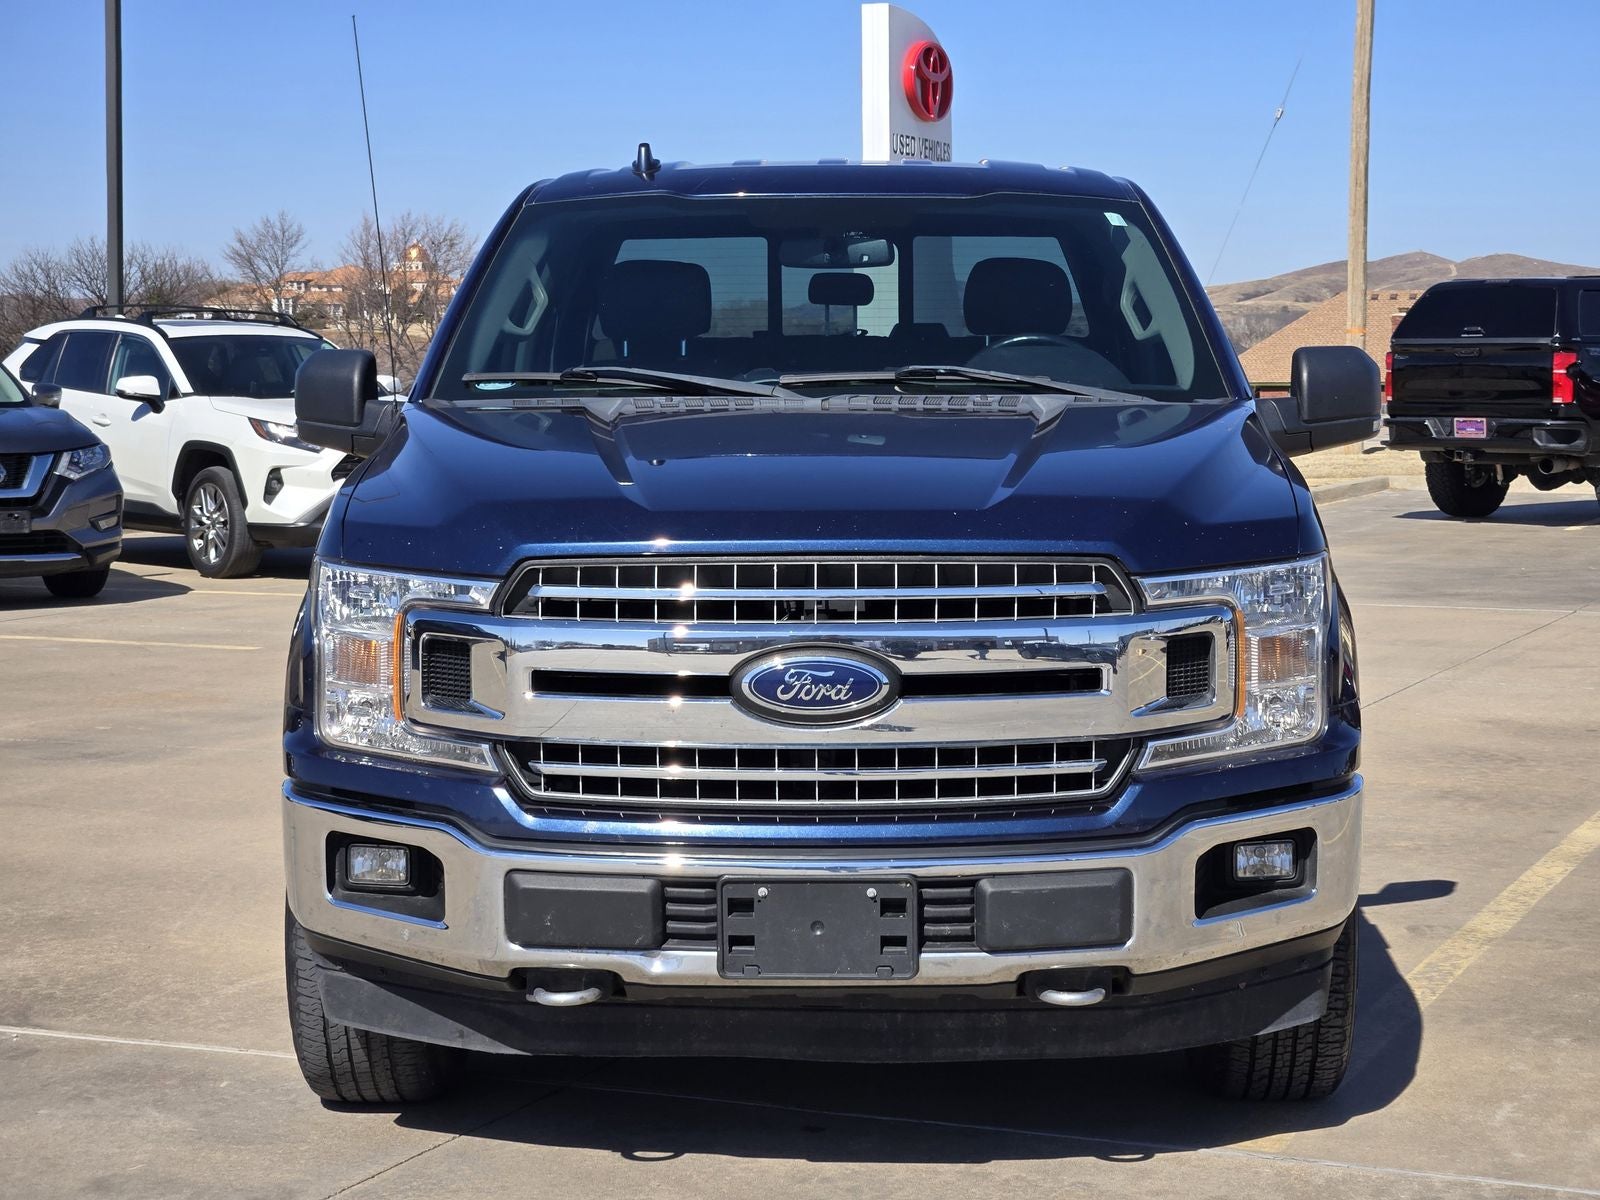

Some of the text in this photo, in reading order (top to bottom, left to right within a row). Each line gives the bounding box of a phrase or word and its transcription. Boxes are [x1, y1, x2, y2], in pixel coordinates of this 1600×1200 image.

[892, 133, 951, 162] USED VEHICLES
[776, 668, 854, 701] Ford
